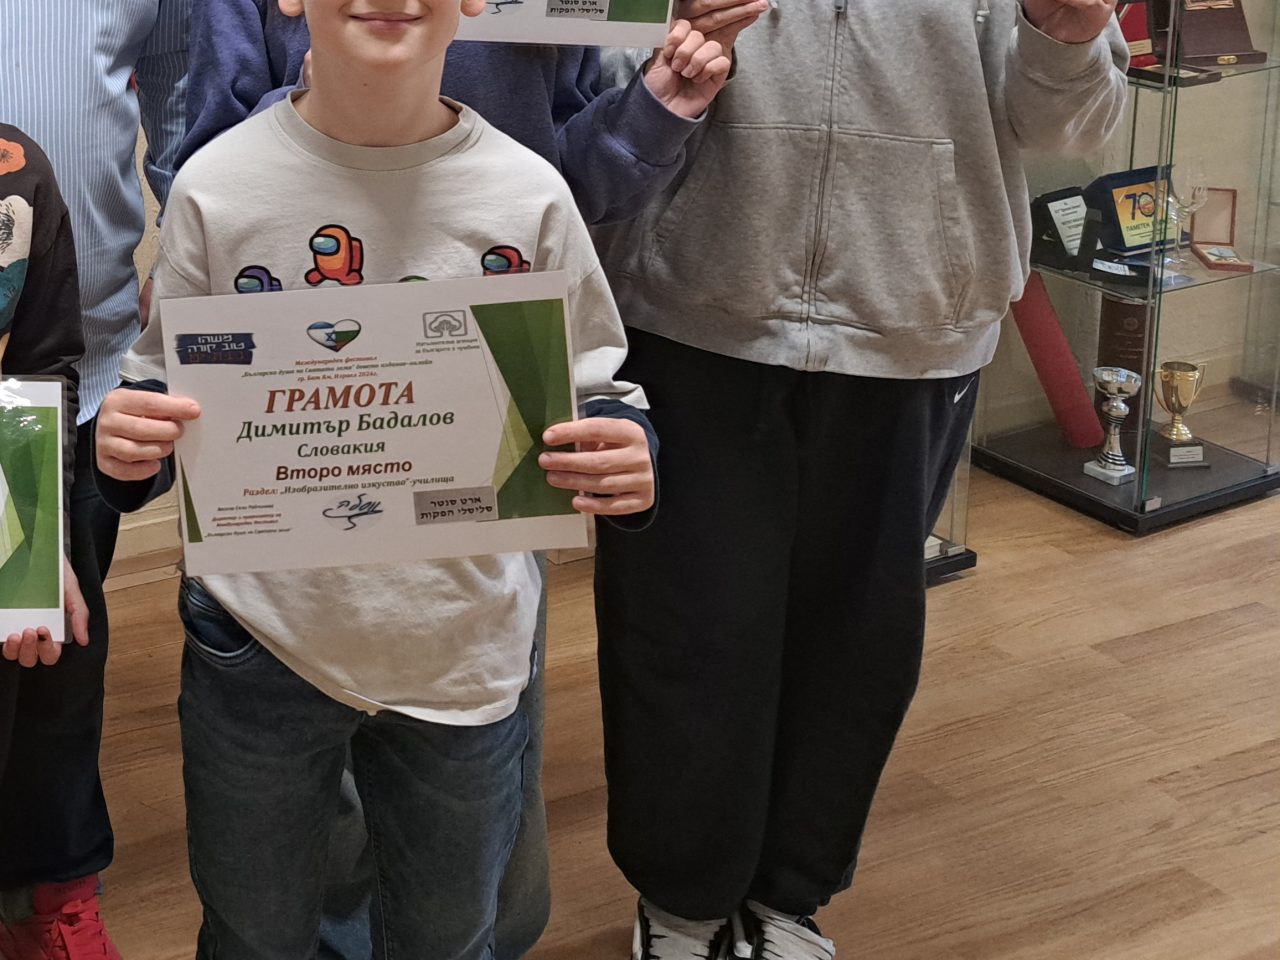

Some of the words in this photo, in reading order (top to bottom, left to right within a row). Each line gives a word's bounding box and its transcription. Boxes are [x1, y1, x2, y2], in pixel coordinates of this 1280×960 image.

[264, 380, 415, 413] ГРАМОТА
[236, 418, 351, 443] Димитър
[357, 411, 455, 432] Бадалов
[297, 441, 386, 458] Словакия
[275, 464, 342, 482] Второ
[346, 460, 413, 477] място
[243, 488, 279, 497] Раздел:
